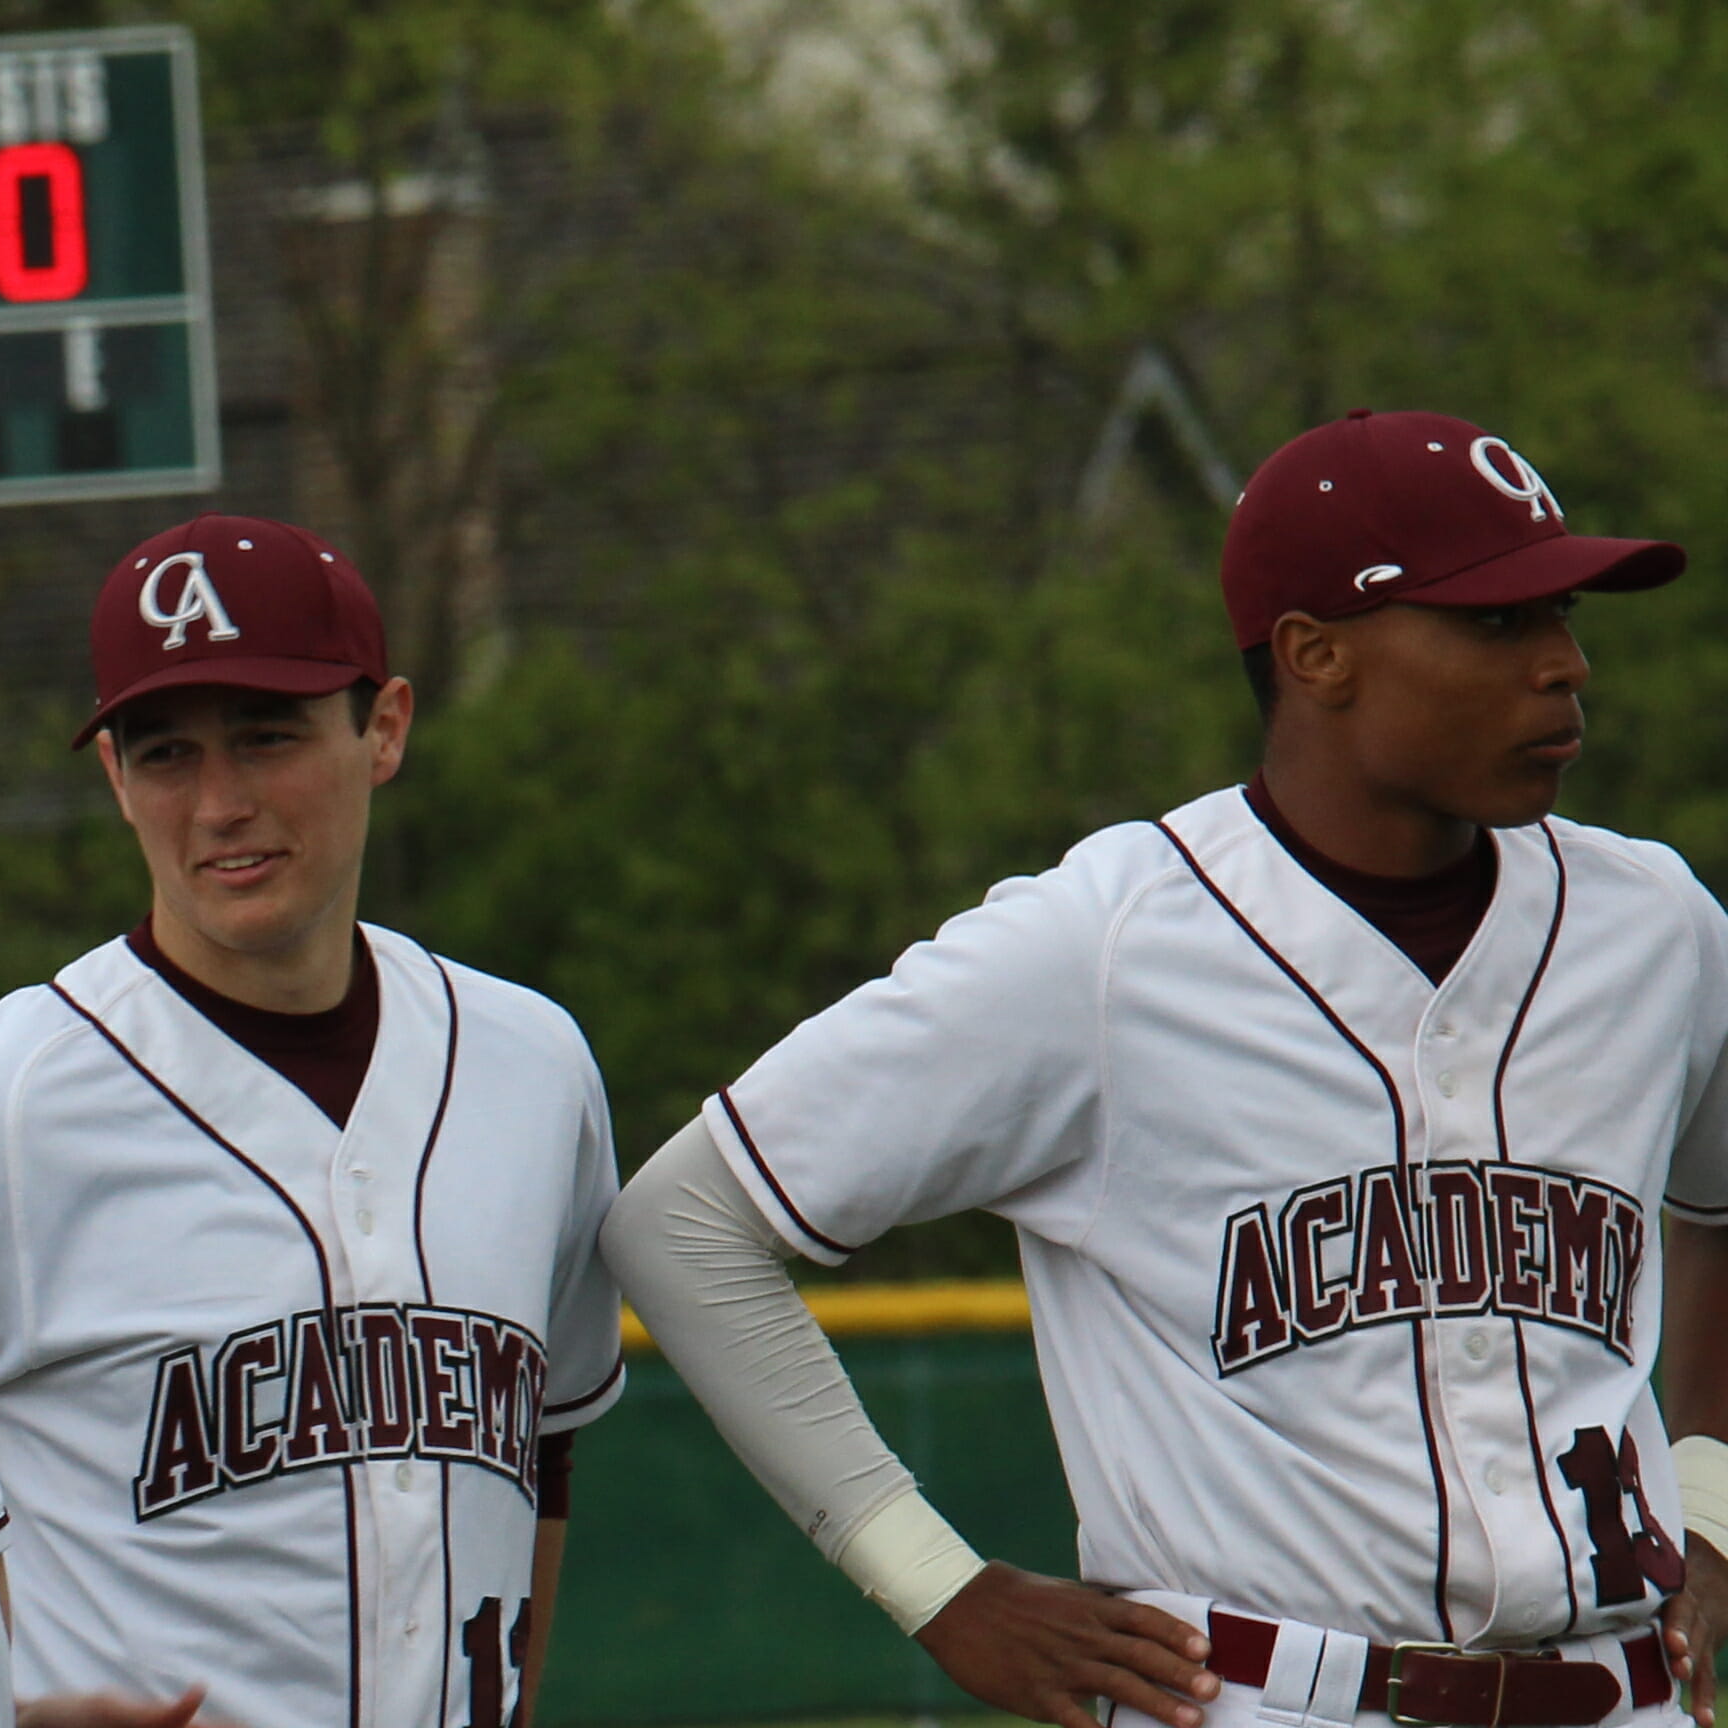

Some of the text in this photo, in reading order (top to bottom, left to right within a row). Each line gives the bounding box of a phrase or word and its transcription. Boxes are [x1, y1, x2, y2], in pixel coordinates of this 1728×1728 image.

[139, 551, 241, 651] CA
[1210, 1160, 1645, 1380] ACADEMY
[133, 1302, 549, 1524] ACADEMY
